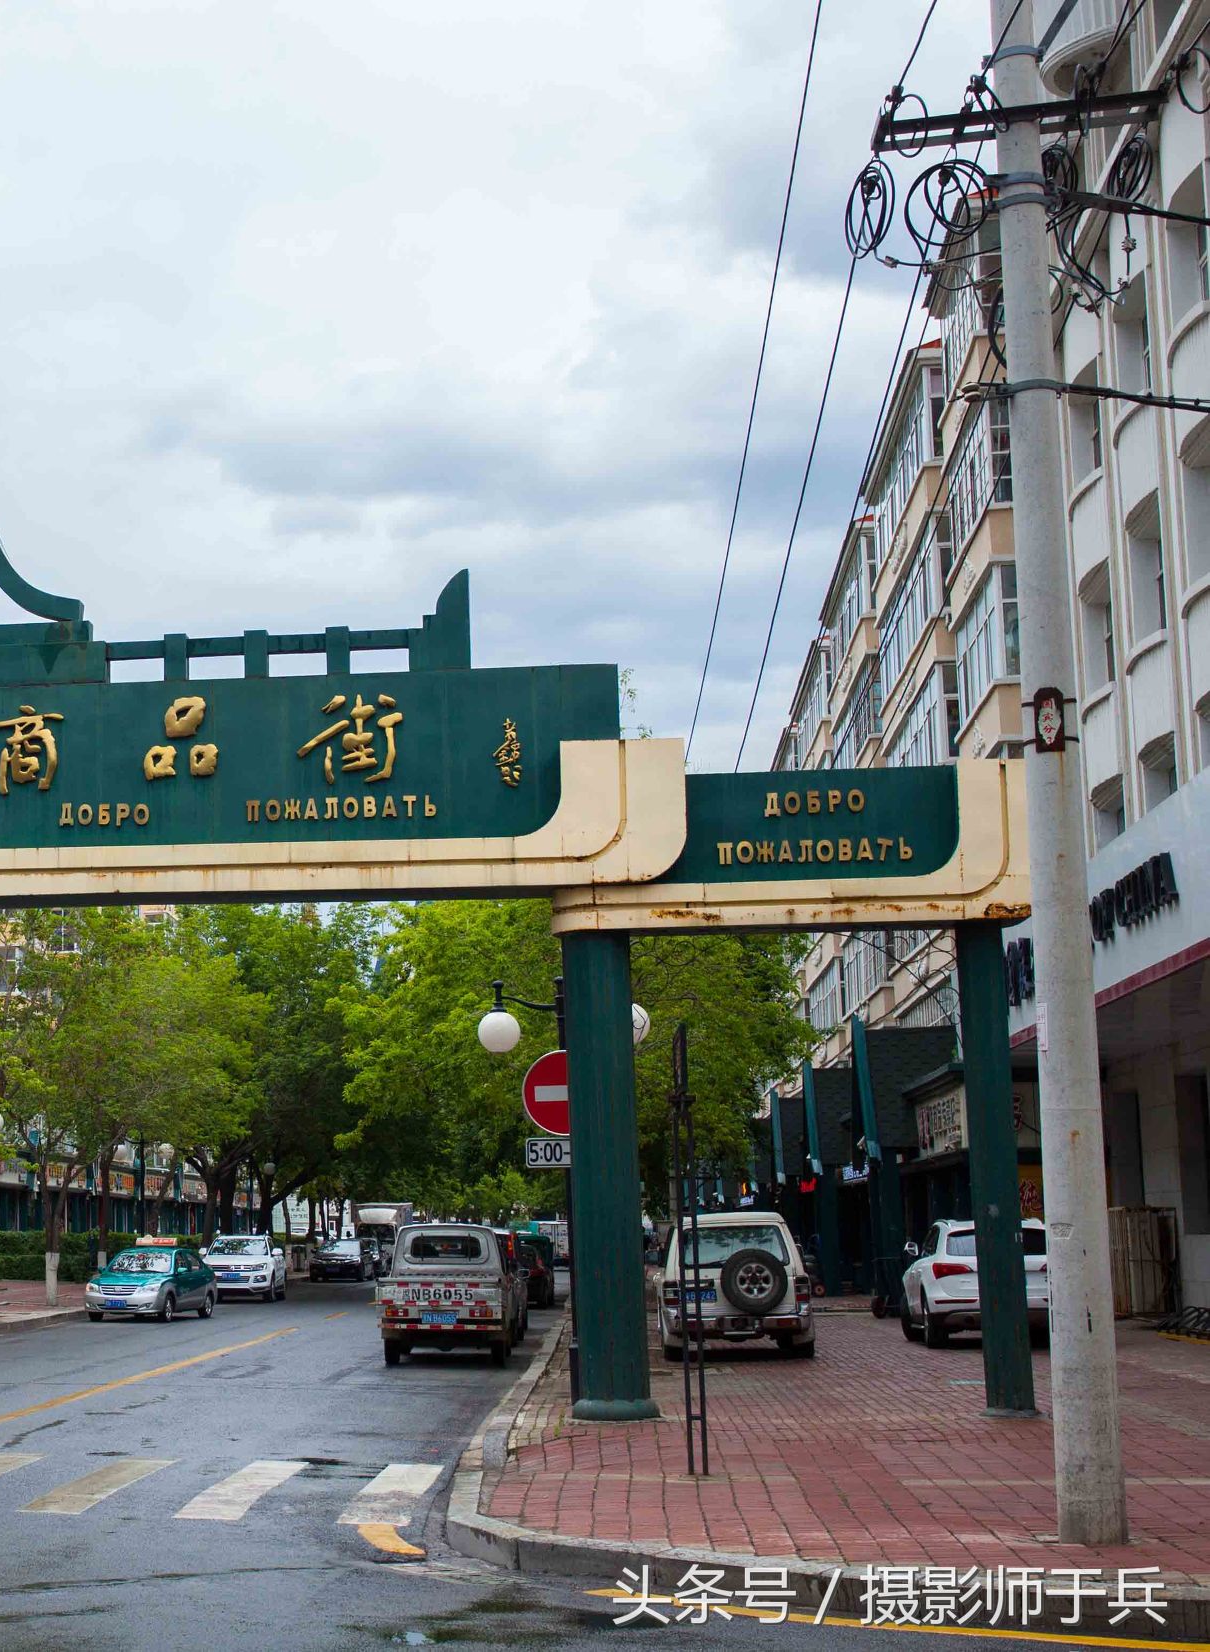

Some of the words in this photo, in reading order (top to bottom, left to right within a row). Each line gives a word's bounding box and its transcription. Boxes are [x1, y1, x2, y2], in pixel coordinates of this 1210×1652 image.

[59, 802, 150, 827] ДОБРО
[246, 794, 438, 823] ПОЖАЛОВАТЬ
[764, 788, 865, 818] ДОБРО
[717, 836, 913, 866] ПОЖАЛОВАТЬ
